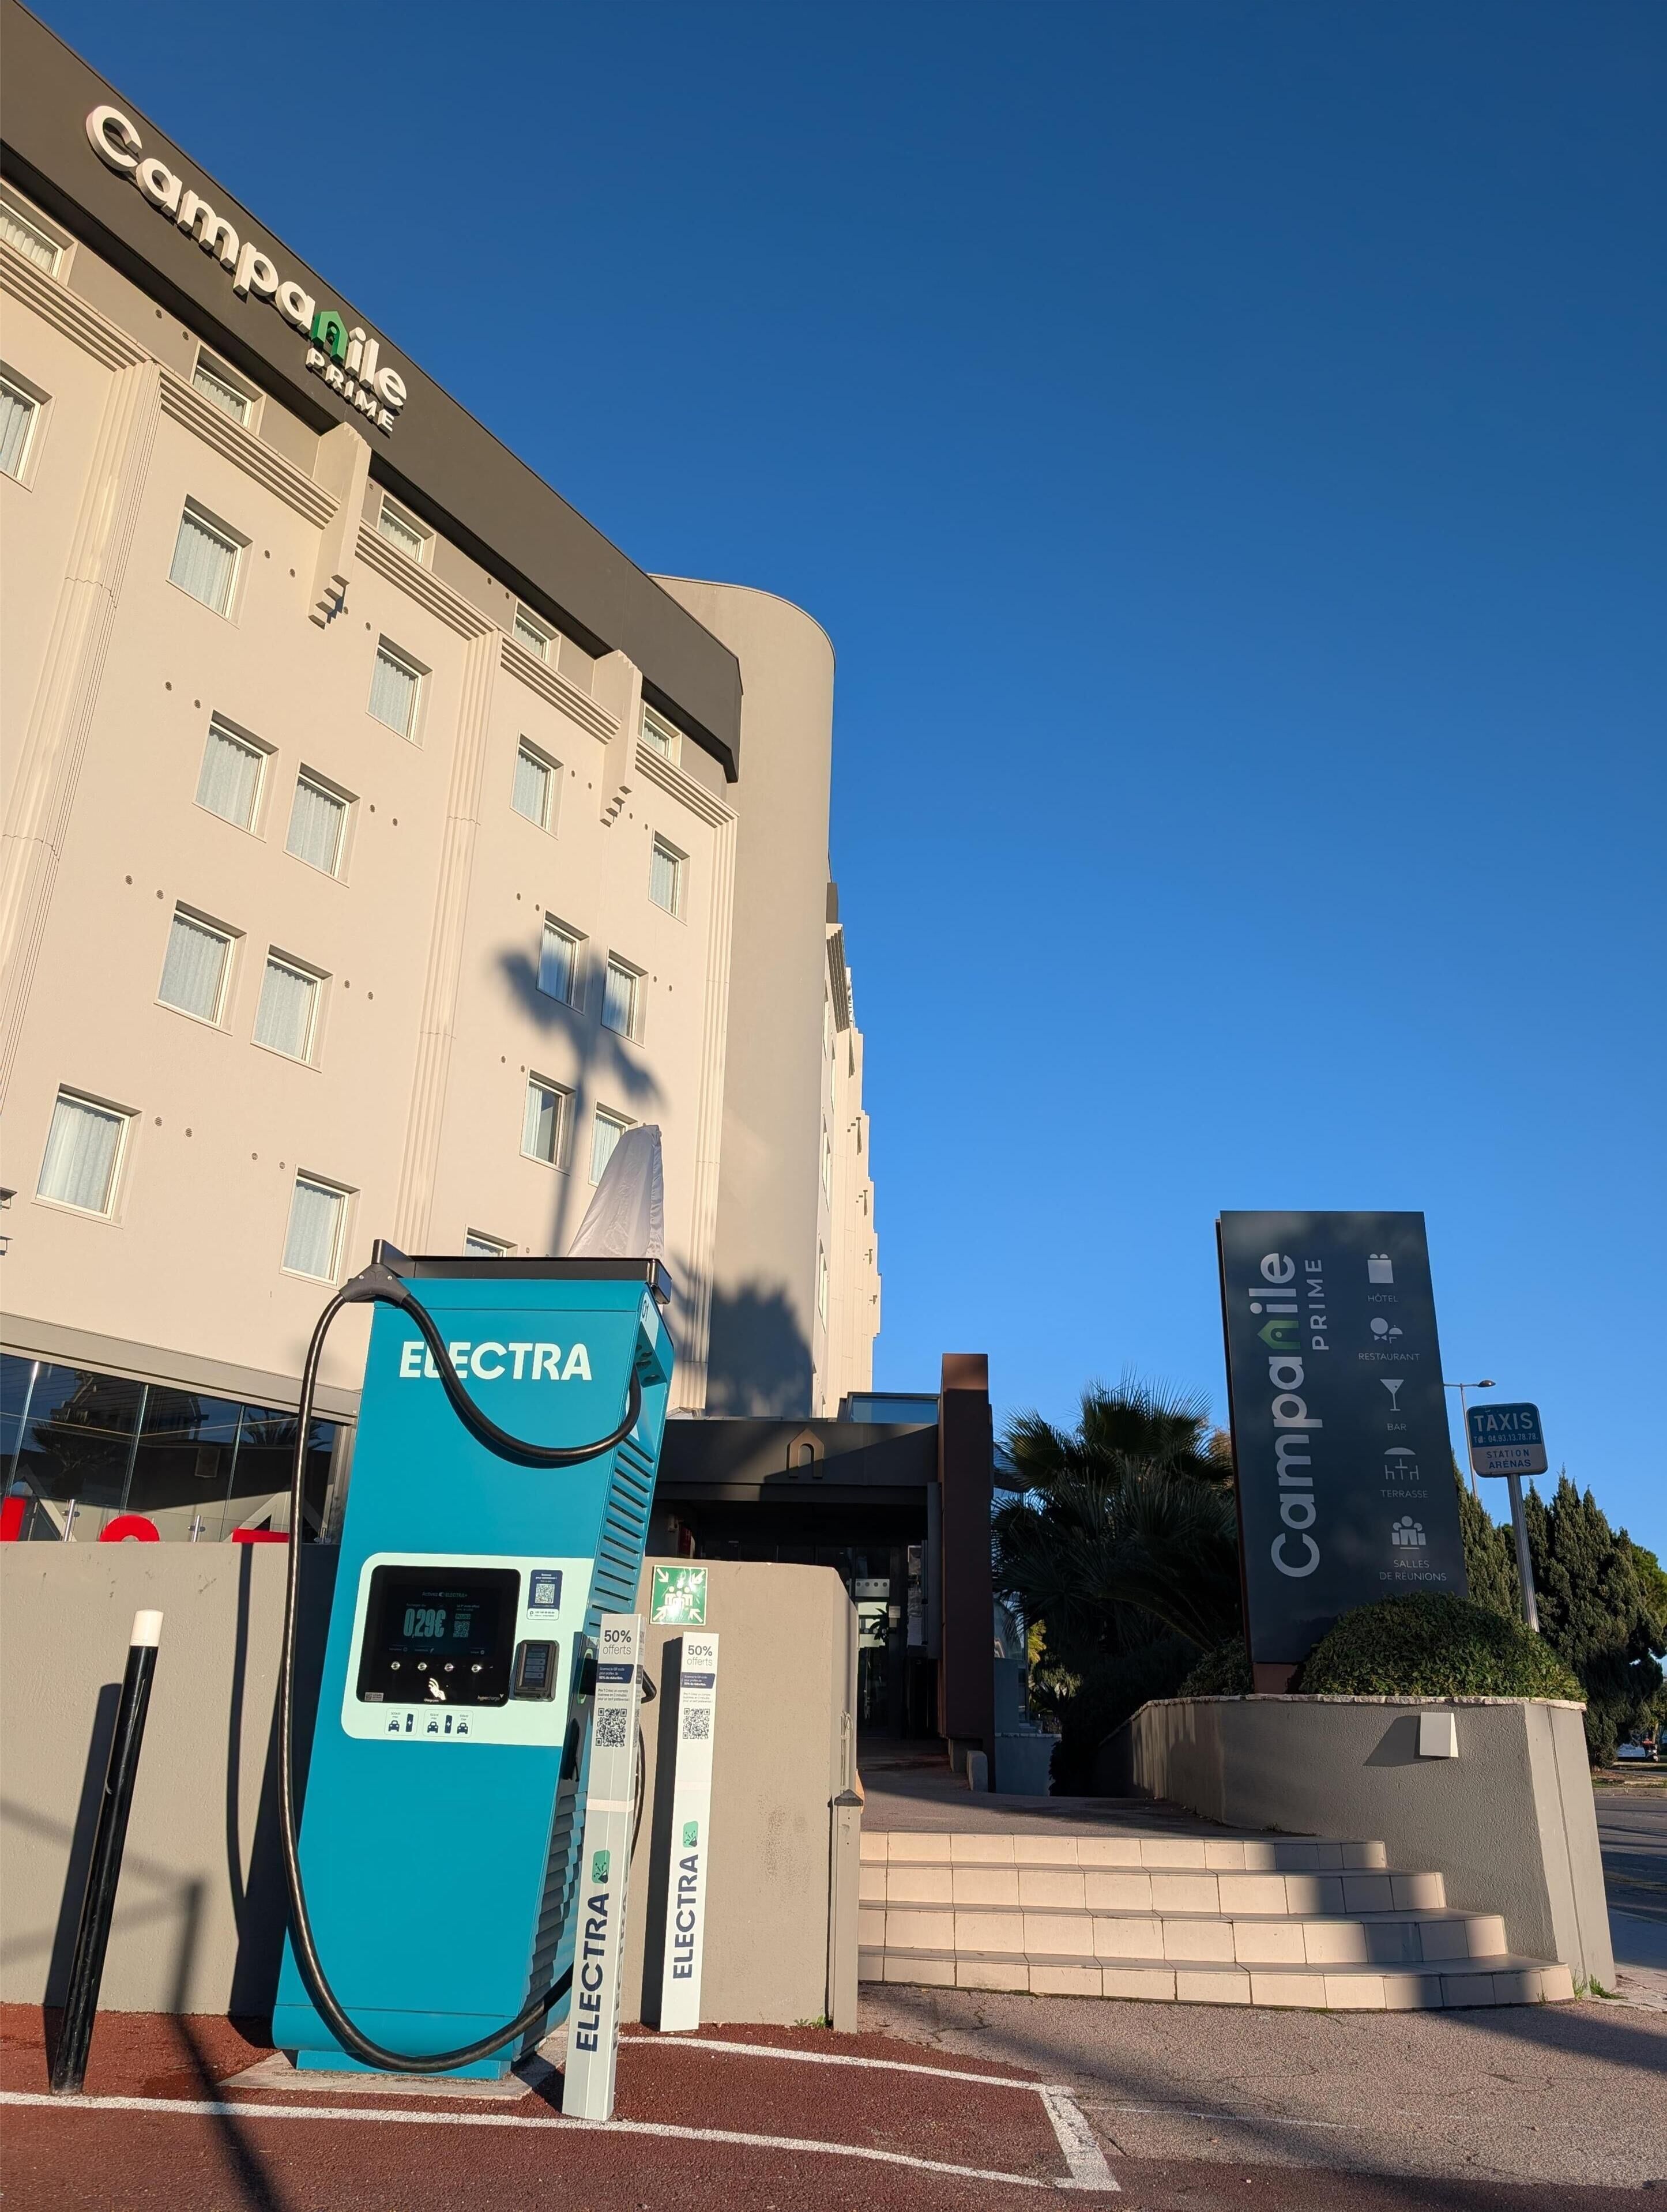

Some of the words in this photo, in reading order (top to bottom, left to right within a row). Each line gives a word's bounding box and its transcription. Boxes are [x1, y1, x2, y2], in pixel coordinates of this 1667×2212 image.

[86, 105, 407, 408] Campanile
[306, 347, 394, 432] PRIME
[1368, 1293, 1398, 1302] HÔTEL
[1305, 1259, 1330, 1350] PRIME
[399, 1341, 592, 1381] ELECTRA
[1358, 1352, 1420, 1361] RESTAURANT
[1248, 1253, 1323, 1578] Campanile
[1387, 1423, 1407, 1431] BAR
[1474, 1412, 1533, 1433] TAXIS
[1487, 1449, 1530, 1459] STATION
[1380, 1489, 1429, 1498] TERRASSE
[1393, 1559, 1429, 1569] SALLES
[1379, 1572, 1392, 1581] DE
[1395, 1570, 1447, 1581] RÉUNIONS
[402, 1607, 447, 1639] 0,29€
[604, 1630, 632, 1643] 50%
[603, 1644, 632, 1656] offerts
[688, 1645, 713, 1656] 50%
[687, 1656, 713, 1667] offerts
[673, 1855, 699, 1979] ELECTRA
[575, 1893, 609, 2052] ELECTRA
